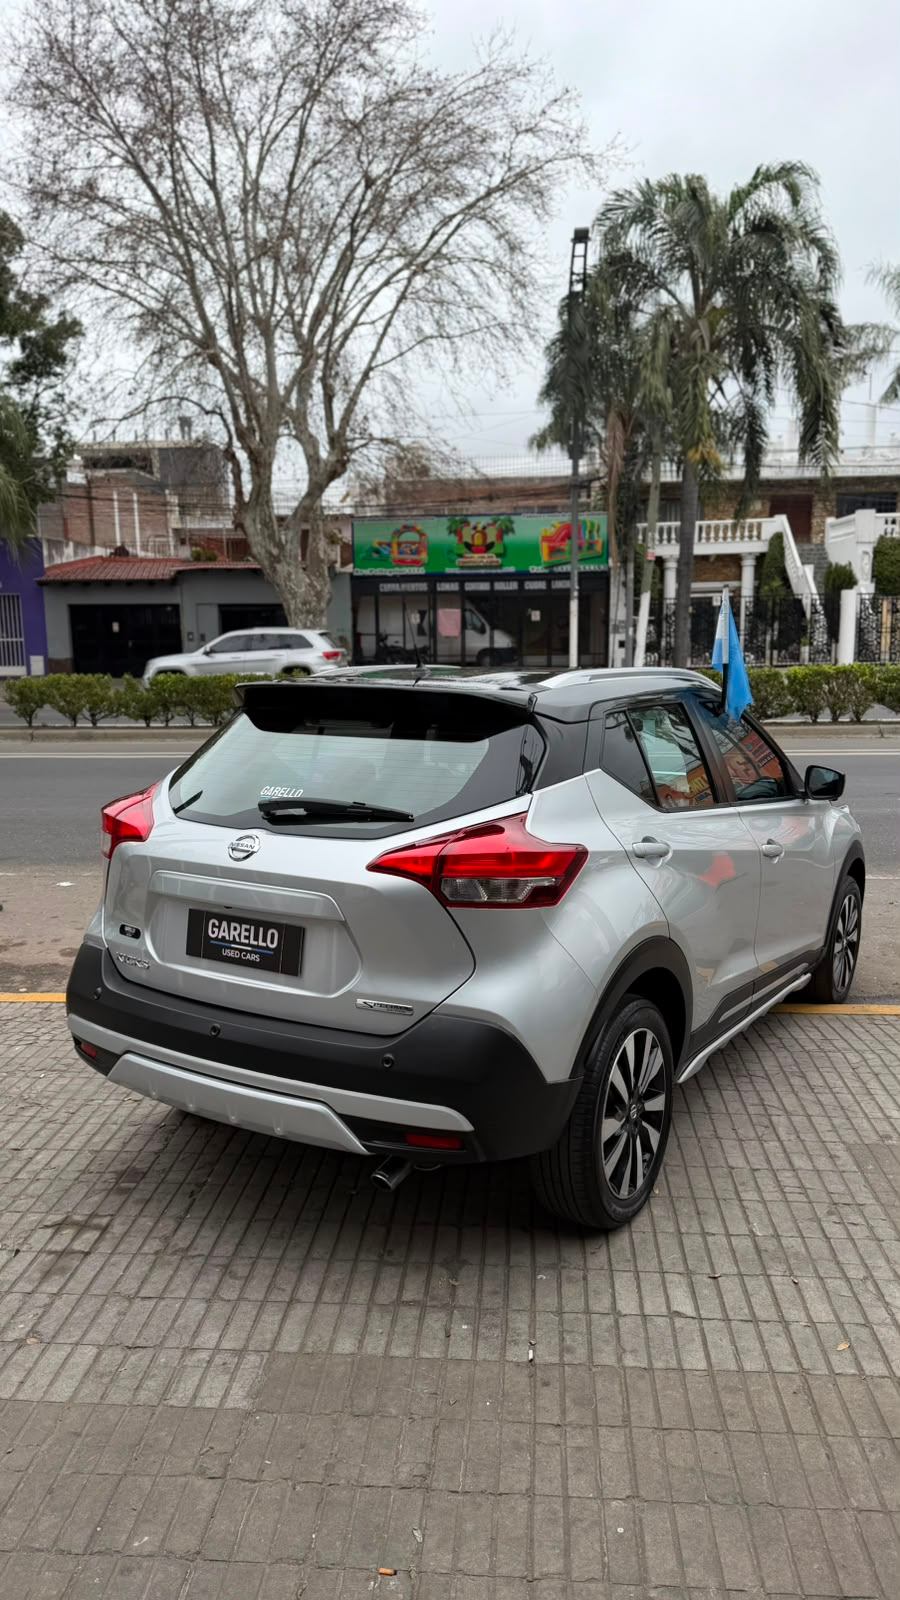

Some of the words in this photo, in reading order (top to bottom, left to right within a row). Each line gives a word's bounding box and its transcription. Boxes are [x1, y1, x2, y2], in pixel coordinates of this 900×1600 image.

[260, 785, 304, 798] GARELLO
[230, 841, 256, 850] NISSAN
[208, 918, 279, 949] GARELLO
[222, 948, 240, 959] USED
[241, 951, 260, 962] CARS
